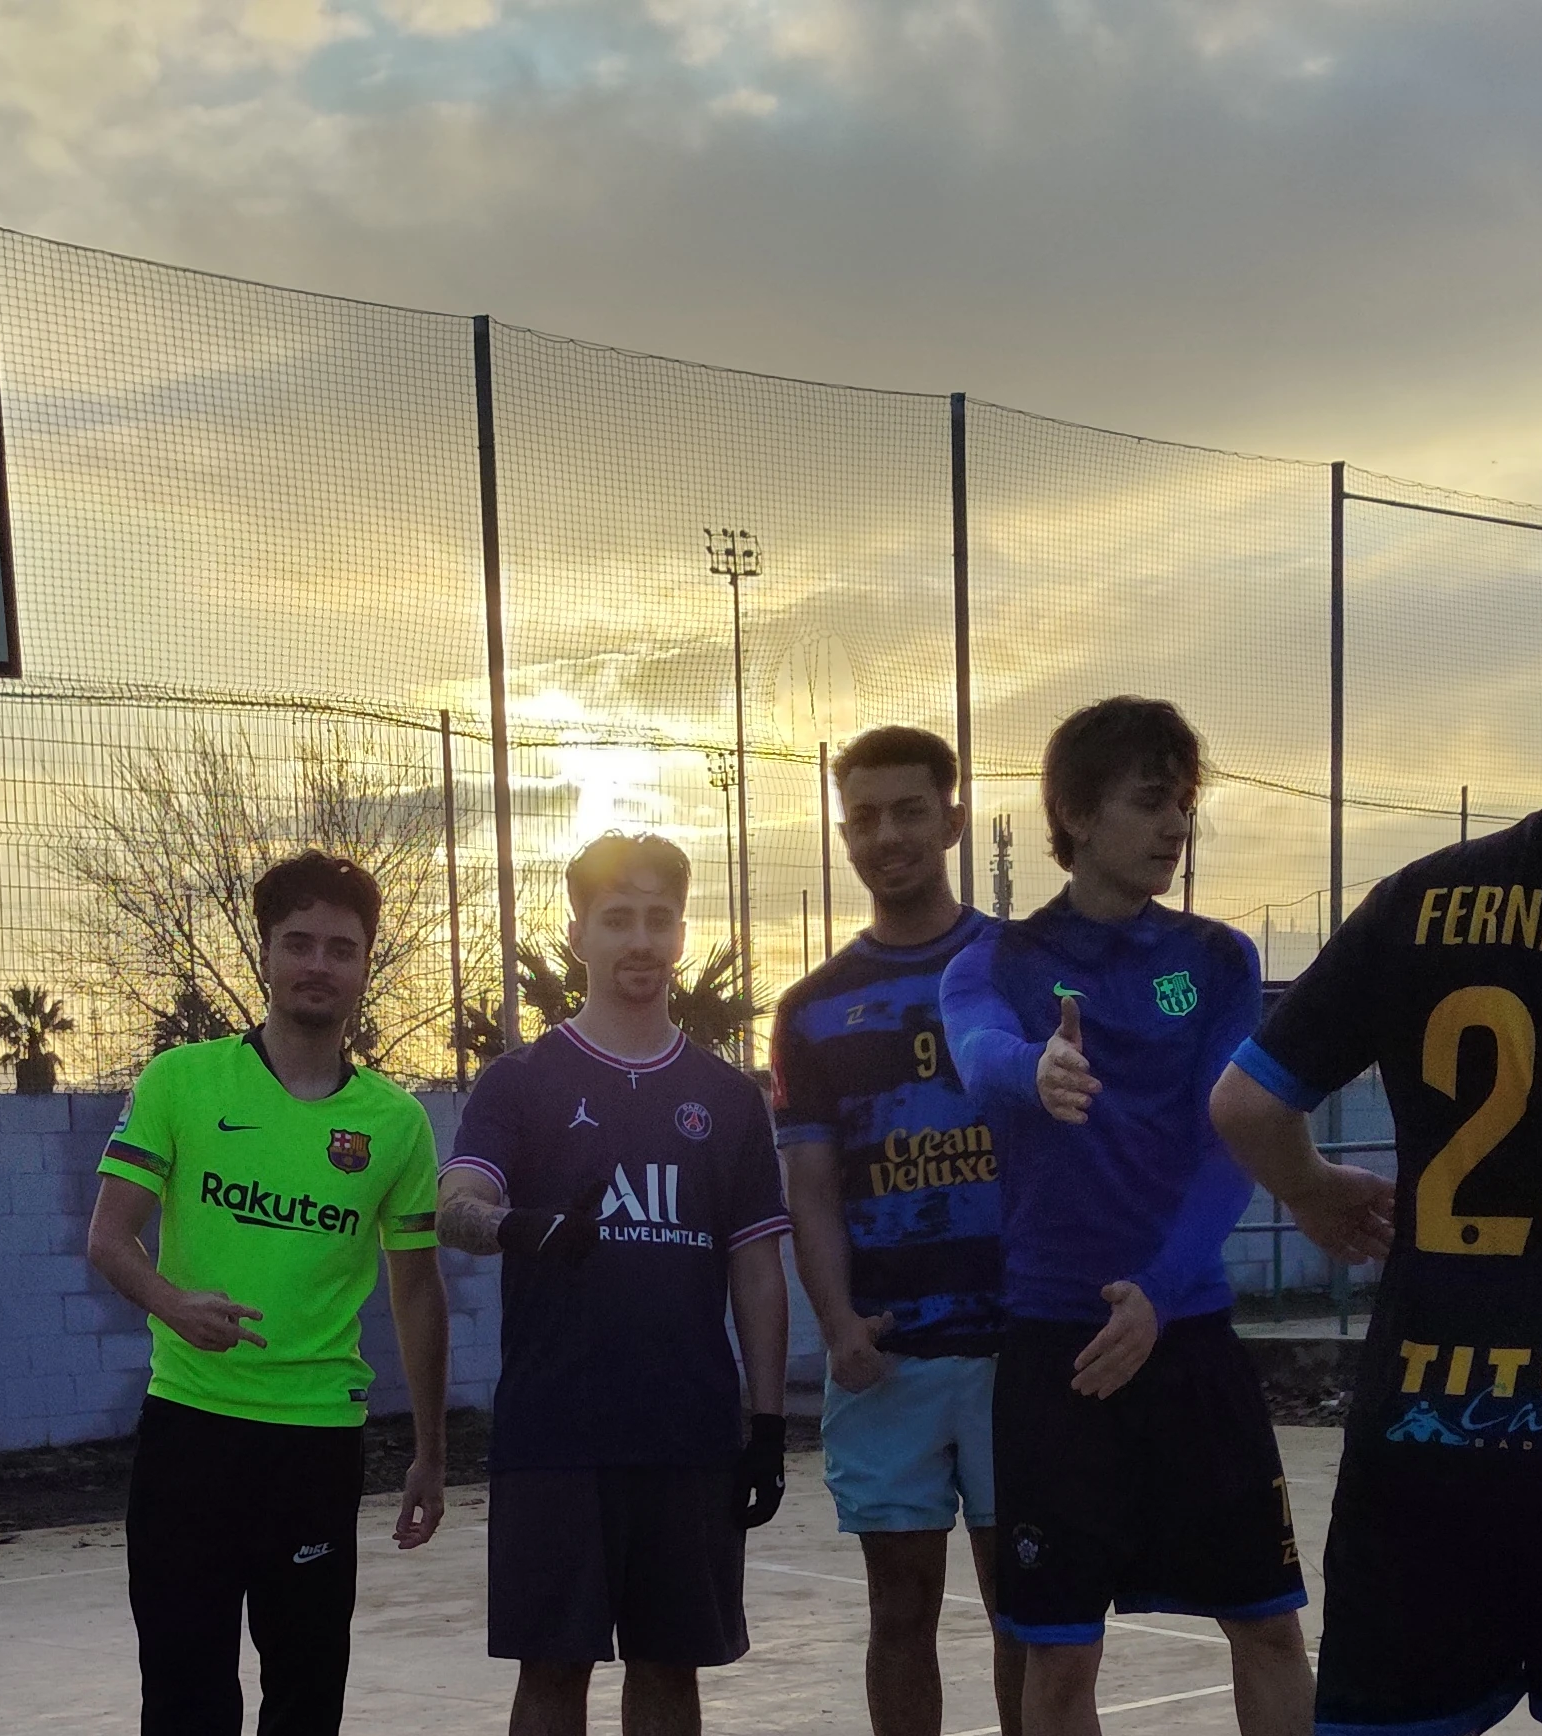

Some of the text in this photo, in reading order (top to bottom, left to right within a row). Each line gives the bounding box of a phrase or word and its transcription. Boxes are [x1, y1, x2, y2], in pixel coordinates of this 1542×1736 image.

[913, 1031, 937, 1078] 9
[869, 1154, 1000, 1197] Deluxe
[201, 1171, 360, 1236] Rakuten
[615, 1226, 650, 1242] LIVE
[299, 1541, 330, 1556] NIKE
